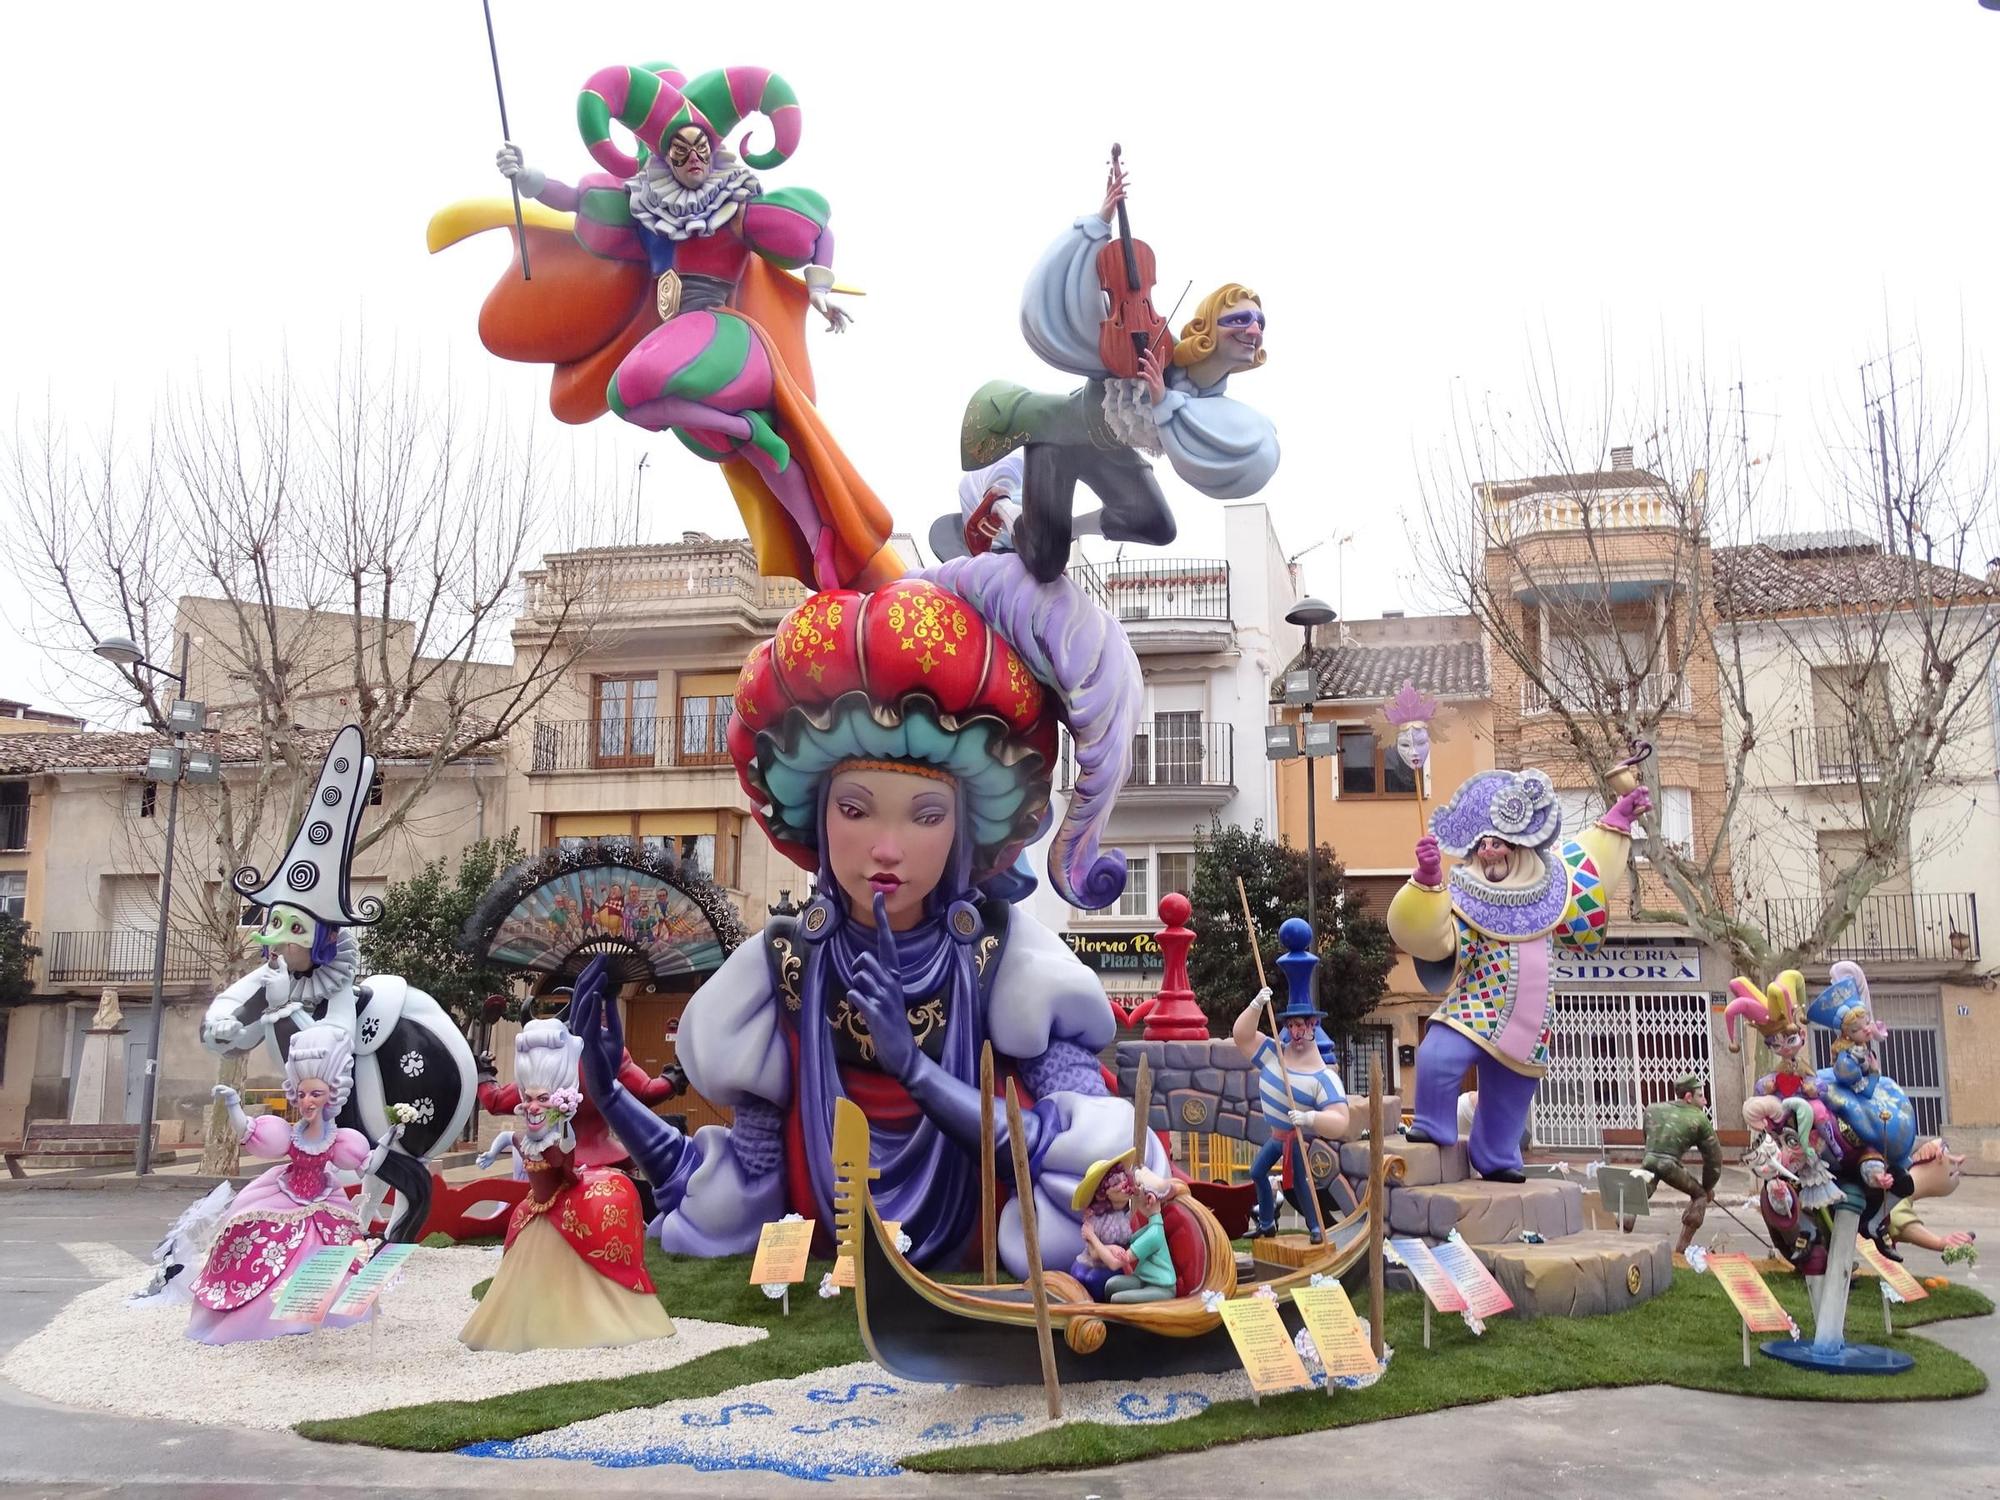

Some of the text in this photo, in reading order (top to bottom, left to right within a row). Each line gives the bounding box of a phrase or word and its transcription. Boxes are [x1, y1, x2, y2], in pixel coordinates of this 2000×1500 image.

[1073, 934, 1161, 953] Horno Pa
[1101, 954, 1139, 968] Plaza
